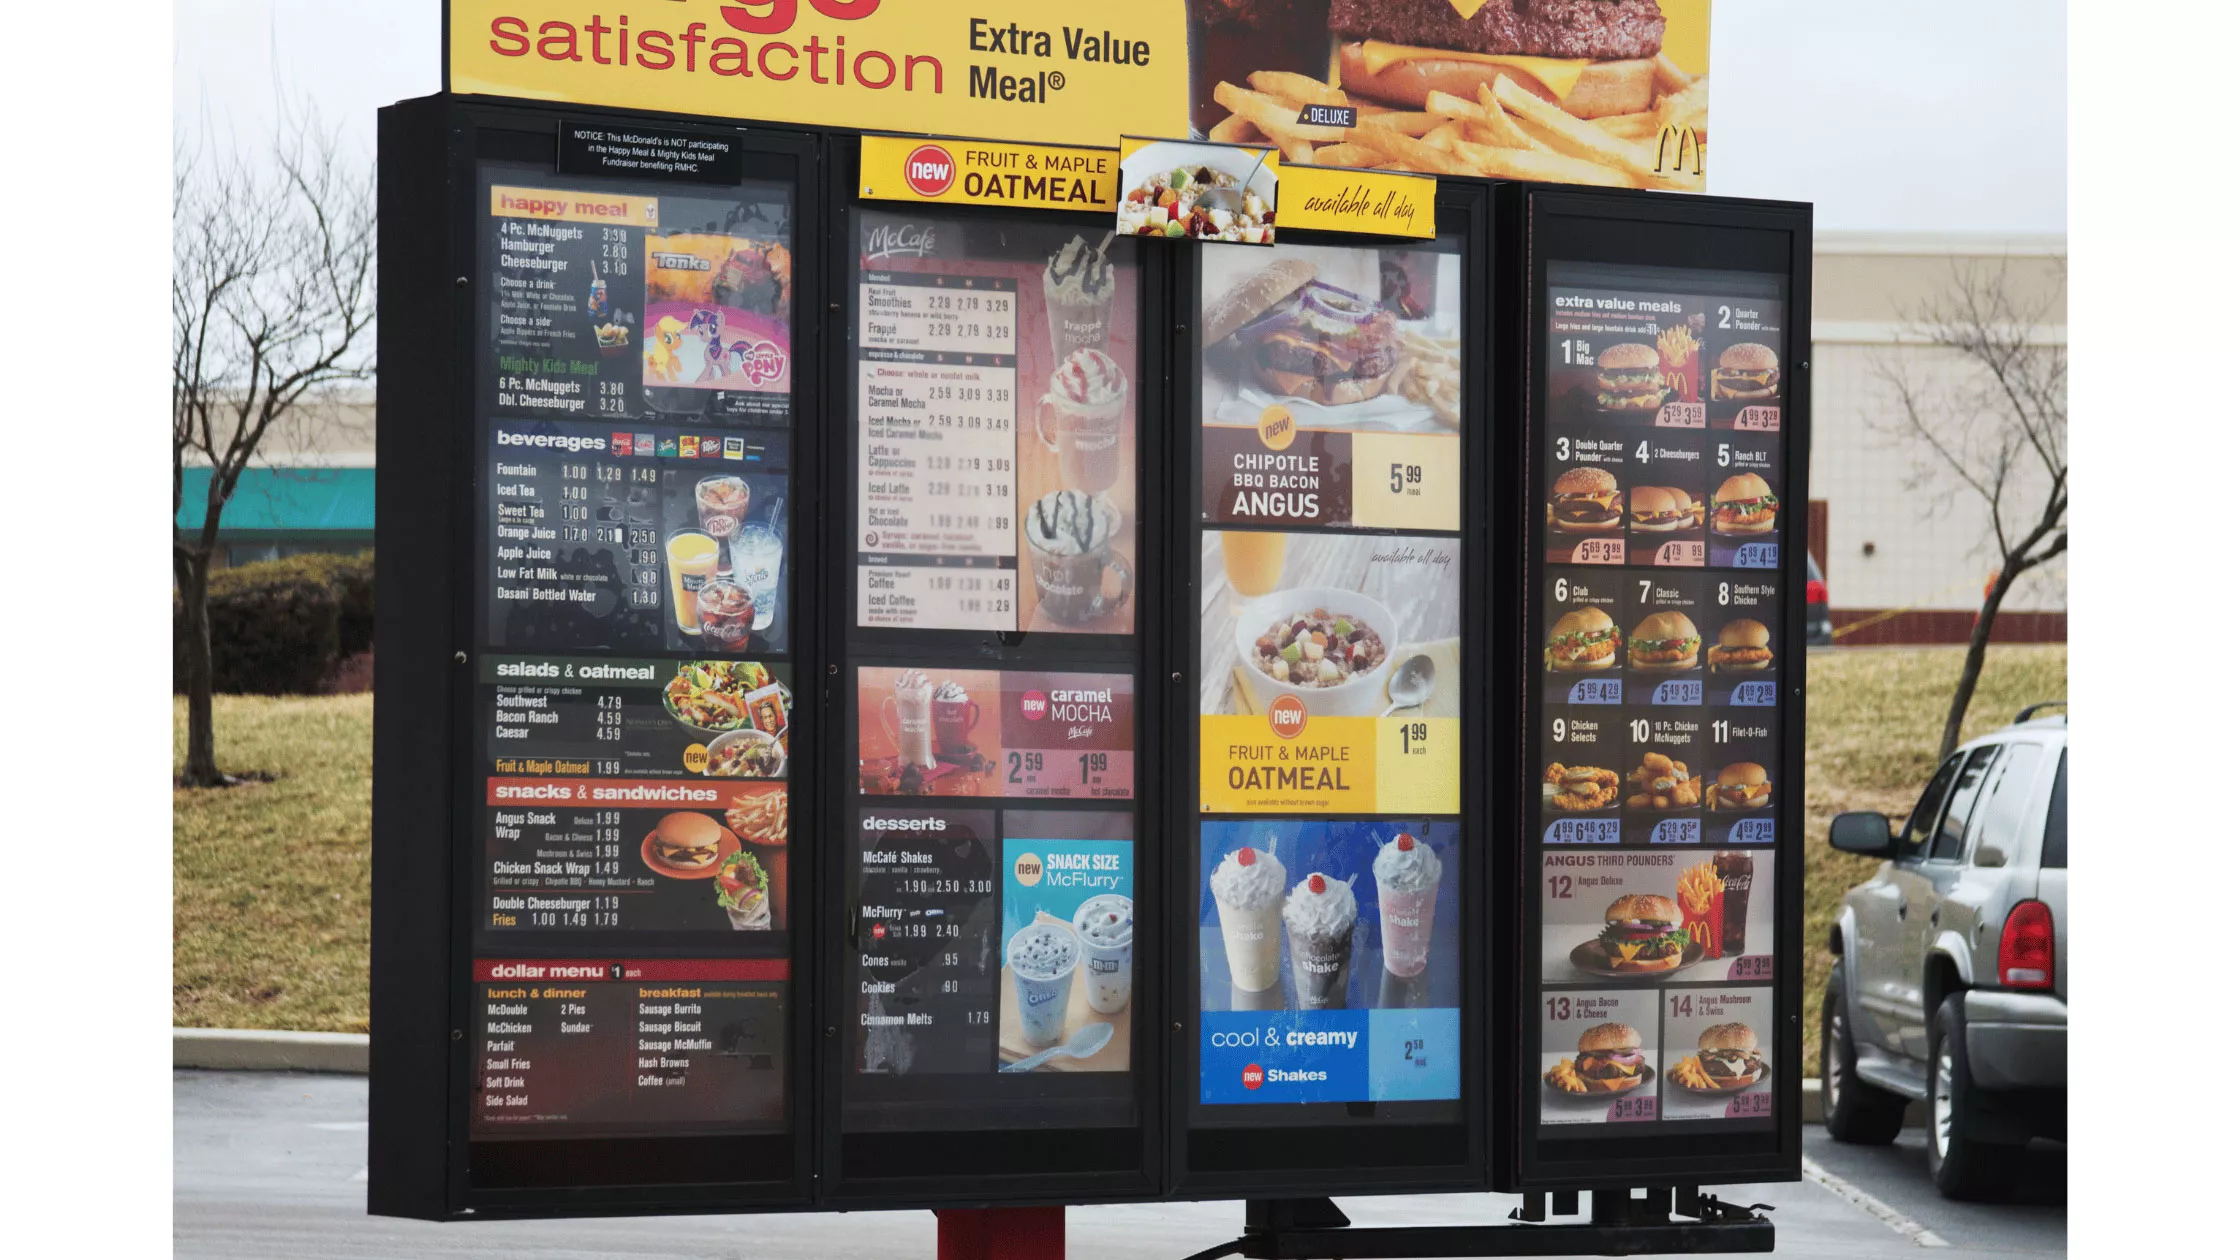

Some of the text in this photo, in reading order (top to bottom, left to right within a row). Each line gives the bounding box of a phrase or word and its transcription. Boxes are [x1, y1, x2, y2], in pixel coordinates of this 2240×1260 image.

[969, 18, 1151, 67] Extra Value
[489, 15, 944, 95] satisfaction
[1311, 108, 1349, 124] DELUXE
[575, 131, 605, 141] NOTICE:
[607, 133, 621, 142] This
[623, 135, 662, 145] McDonald's
[671, 139, 686, 147] NOT
[689, 140, 728, 152] participating
[608, 146, 630, 156] Happy
[632, 148, 649, 156] Meal
[651, 149, 655, 157] &
[658, 150, 679, 160] Mighty
[682, 151, 696, 160] Kids
[698, 152, 714, 162] Meal
[966, 151, 1107, 173] FRUIT & MAPLE
[603, 158, 699, 172] Fundraiser benefiting RMHC.
[912, 162, 949, 181] new
[964, 173, 1106, 204] OATMEAL
[501, 194, 627, 217] happy meal
[1304, 185, 1414, 231] available all day
[501, 222, 507, 233] 4
[510, 223, 525, 235] Pc.
[528, 224, 583, 240] McNuggets
[501, 238, 627, 259] Hamburger 2.80
[868, 224, 935, 260] McCafé
[501, 254, 568, 272] Cheeseburger
[868, 296, 1008, 312] Smoothies 2.29 2.79 3.29
[1556, 296, 1681, 313] extra value meals
[1718, 306, 1730, 329] 2
[1065, 332, 1101, 345] mocha
[1562, 340, 1590, 364] 1 Big
[1576, 354, 1594, 365] Mac
[500, 356, 598, 376] Mighty Kids Meal
[500, 377, 624, 395] 6 Pc. McNuggets 3.80
[499, 393, 624, 412] Dbl. Cheeseburger 3.20
[1265, 416, 1290, 439] new
[497, 430, 606, 452] beverages
[1556, 437, 1570, 461] 3
[1635, 441, 1649, 463] 4
[1717, 444, 1730, 467] 5
[1233, 453, 1319, 472] CHIPOTLE
[497, 463, 656, 482] Fountain 1.00 1.29 1.49
[1234, 474, 1319, 489] BBQ BACON
[1232, 492, 1320, 518] ANGUS
[498, 527, 556, 541] Orange Juice
[1371, 547, 1451, 571] available all day
[498, 567, 557, 580] Low Fat Milk
[1555, 578, 1588, 602] 6 Club
[1639, 580, 1679, 603] 7 Classic
[1718, 582, 1729, 606] 8
[497, 662, 655, 680] salads & oatmeal
[496, 694, 622, 709] Southwest 4.79
[1051, 688, 1112, 703] caramel
[1023, 699, 1045, 712] new
[1051, 704, 1112, 722] MOCHA
[496, 711, 558, 724] Bacon Ranch
[1274, 709, 1302, 725] new
[1553, 718, 1598, 742] 9 Chicken
[1571, 732, 1596, 742] Selects
[1630, 719, 1649, 743] 10
[1712, 720, 1768, 743] 11 Filet-O-Fish
[686, 750, 707, 764] new
[1229, 746, 1349, 761] FRUIT & MAPLE
[1229, 767, 1350, 791] OATMEAL
[496, 785, 717, 801] snacks & sandwiches
[863, 817, 946, 831] desserts
[863, 851, 933, 864] McCafé Shakes
[1047, 854, 1119, 870] SNACK SIZE
[1545, 855, 1673, 866] ANGUS THIRD POUNDERS
[494, 861, 619, 877] Chicken Snack Wrap 1.49
[1018, 862, 1041, 875] new
[1548, 875, 1572, 899] 12
[493, 912, 618, 927] Fries 1.00 1.49 1.79
[491, 965, 603, 978] dollar menu
[488, 988, 586, 999] lunch & dinner
[639, 988, 701, 998] breakfast
[861, 981, 895, 993] Cookies
[488, 1004, 528, 1015] McDouble
[487, 1022, 532, 1034] McChicken
[1211, 1027, 1358, 1049] cool & creamy
[639, 1058, 689, 1069] Hash Browns
[1244, 1072, 1261, 1082] new
[1267, 1069, 1327, 1081] Shakes
[486, 1095, 528, 1106] Side Salad
